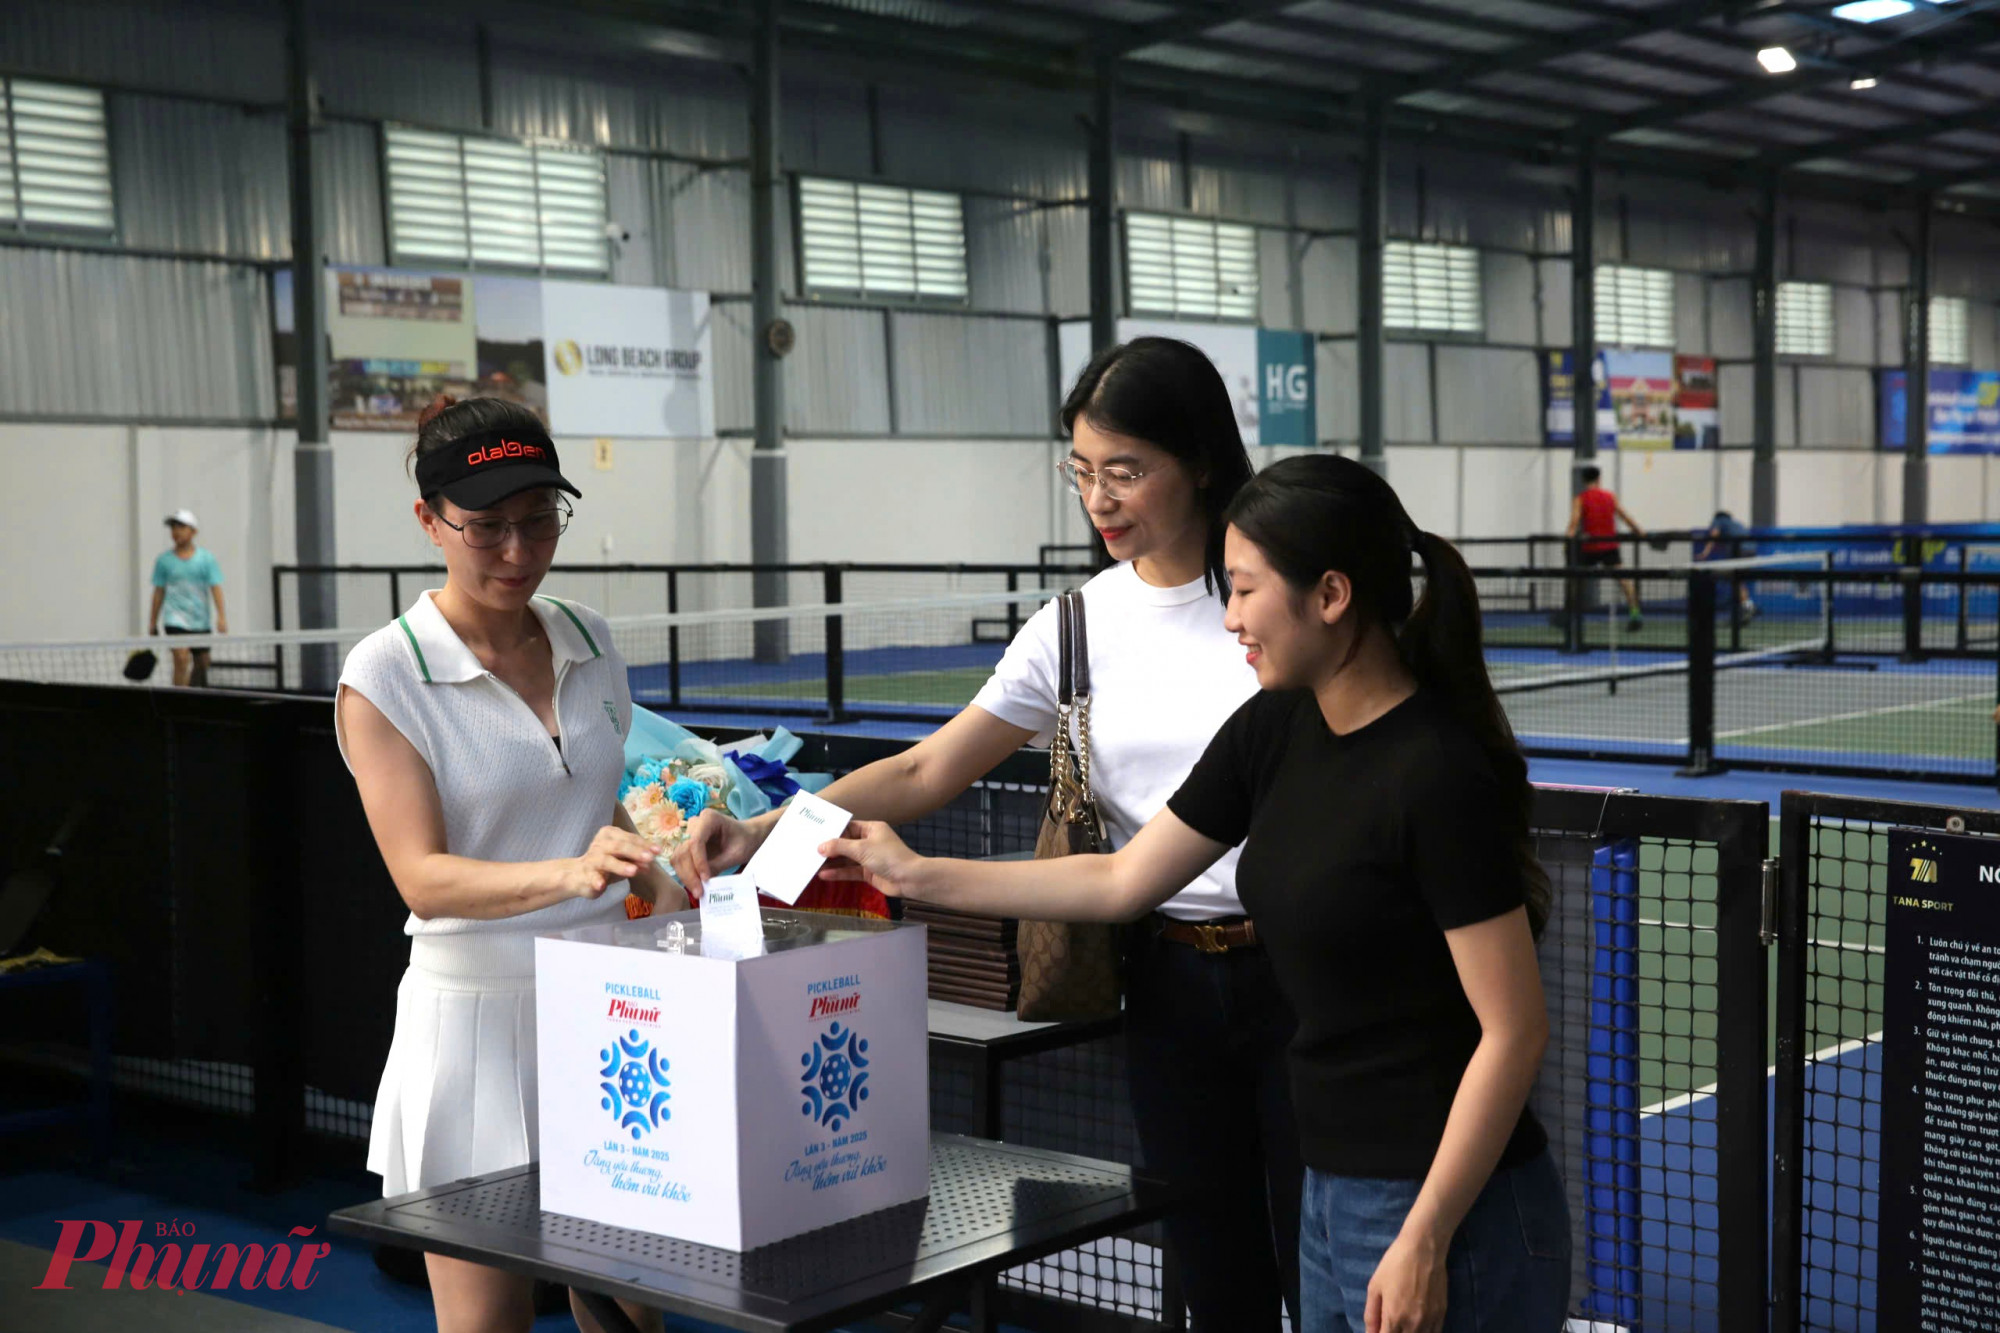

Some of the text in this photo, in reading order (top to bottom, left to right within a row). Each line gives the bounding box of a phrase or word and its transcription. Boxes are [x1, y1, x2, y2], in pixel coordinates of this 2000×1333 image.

[622, 346, 662, 368] BEACH
[665, 349, 702, 370] GROUP
[1266, 363, 1307, 400] HG
[1893, 896, 1954, 912] TANA SPORT
[1917, 936, 1923, 944] 1.
[1930, 937, 1947, 947] Luôn
[1929, 952, 1949, 962] tránh
[1961, 956, 1980, 967] chạm
[605, 982, 661, 1000] PICKLEBALL
[806, 974, 861, 995] PICKLEBALL
[1915, 981, 1922, 990] 2.
[1929, 982, 1941, 992] Tôn
[1944, 986, 1964, 998] trọng
[1928, 999, 1946, 1009] xung
[1914, 1026, 1920, 1035] 3.
[1952, 1033, 1967, 1042] sinh
[1926, 1042, 1950, 1056] Không
[1912, 1085, 1919, 1093] 4.
[1943, 1092, 1963, 1104] trang
[1946, 1105, 1966, 1118] Mang
[821, 1142, 825, 1151] 3
[850, 1130, 868, 1143] 2025
[1925, 1131, 1945, 1143] mang
[620, 1144, 625, 1153] 3
[651, 1149, 670, 1161] 2025
[1924, 1157, 1935, 1167] khi
[1938, 1161, 1957, 1171] tham
[1960, 1165, 1970, 1174] gia
[1910, 1186, 1917, 1194] 5.
[1959, 1210, 1975, 1220] gian
[1910, 1231, 1916, 1239] 6.
